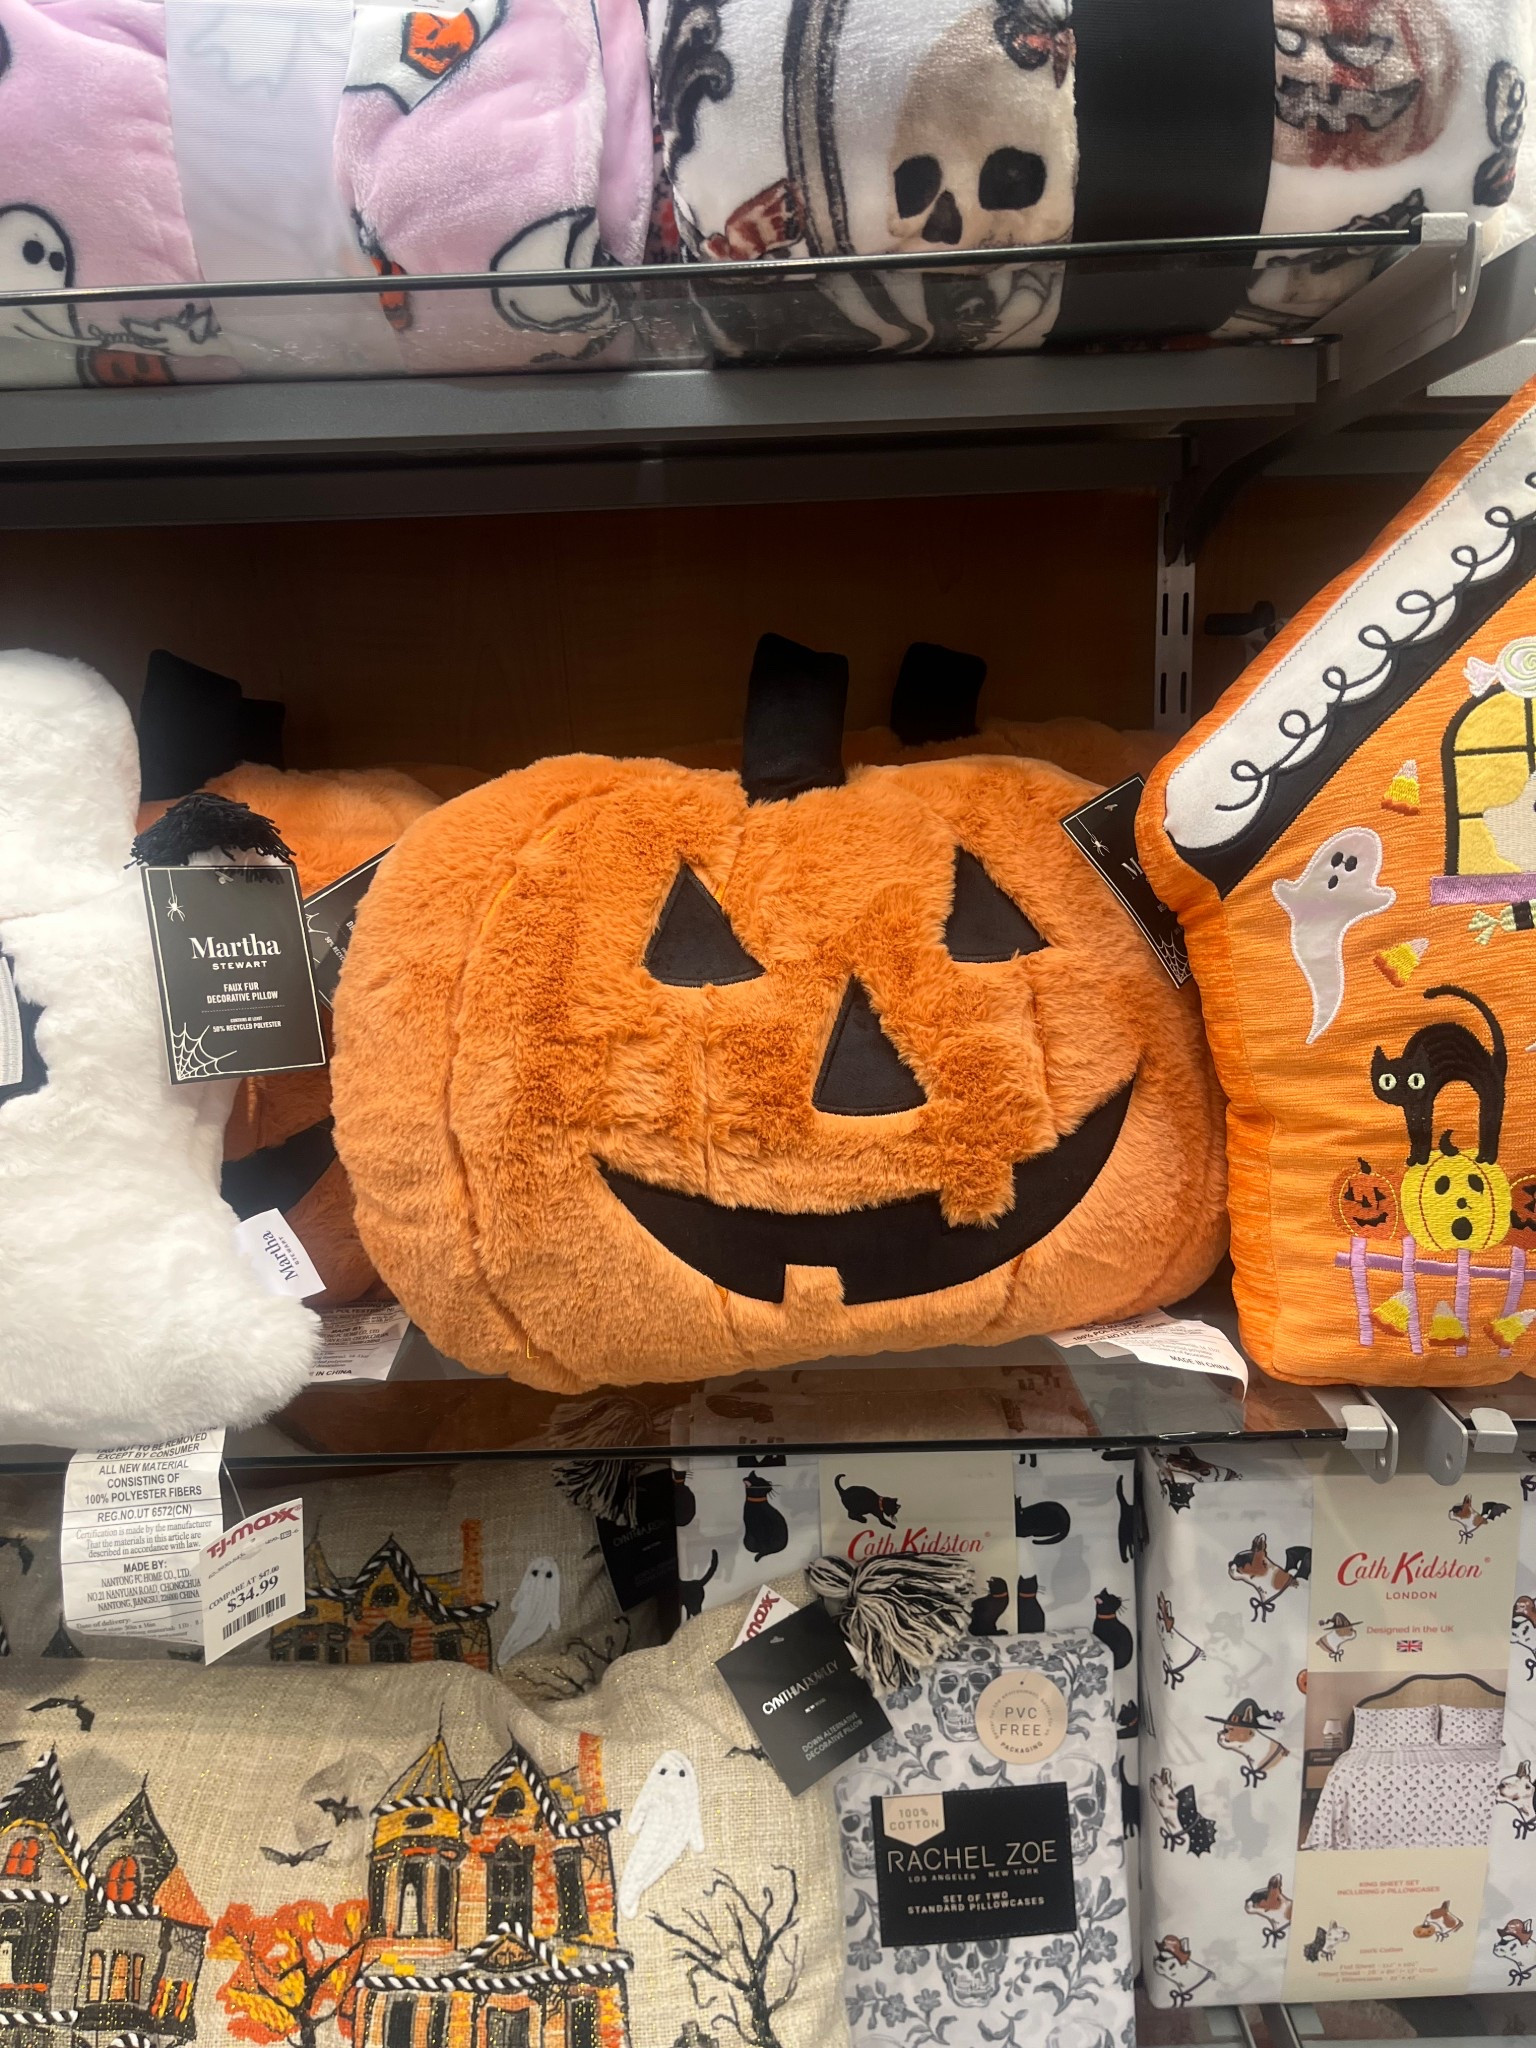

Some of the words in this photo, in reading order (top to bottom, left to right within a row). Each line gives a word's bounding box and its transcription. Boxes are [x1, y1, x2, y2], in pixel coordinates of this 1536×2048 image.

[189, 933, 282, 959] Martha
[212, 961, 267, 970] STEWART
[223, 983, 243, 992] FAUX
[244, 982, 259, 991] FUR
[207, 992, 250, 1004] DECORATIVE
[252, 991, 278, 1001] PILLOW
[226, 1023, 252, 1031] RECYCLED
[254, 1021, 281, 1030] POLYESTER
[262, 1230, 299, 1281] Martha
[152, 1442, 164, 1450] BE
[165, 1432, 208, 1447] REMOVED
[96, 1452, 132, 1460] EXCEPT
[134, 1451, 148, 1459] BY
[150, 1443, 200, 1458] CONSUMER
[99, 1464, 117, 1475] ALL
[119, 1463, 141, 1474] NEW
[142, 1459, 189, 1472] MATERIAL
[107, 1474, 165, 1489] CONSISTING
[167, 1473, 180, 1483] OF
[85, 1493, 109, 1505] 100%
[111, 1489, 167, 1502] POLYESTER
[169, 1485, 202, 1498] FIBERS
[97, 1508, 150, 1523] REG.NO.UT
[152, 1503, 192, 1518] 6572(CN)
[126, 1525, 145, 1535] made
[146, 1524, 154, 1534] by
[155, 1523, 166, 1532] the
[167, 1519, 212, 1531] manufacturer
[102, 1538, 114, 1548] the
[114, 1536, 145, 1546] materials
[154, 1534, 167, 1542] this
[168, 1532, 190, 1542] article
[848, 1529, 897, 1563] Cath
[900, 1527, 984, 1554] Kidston
[88, 1546, 121, 1559] described
[130, 1543, 169, 1554] accordance
[170, 1541, 185, 1550] with
[124, 1562, 149, 1573] MADE
[151, 1560, 167, 1570] BY:
[1337, 1552, 1390, 1586] Cath
[1391, 1551, 1483, 1585] Kidston
[101, 1573, 134, 1587] NANTONG
[143, 1571, 163, 1582] HOME
[160, 1579, 201, 1593] CHONGCHUA
[179, 1590, 200, 1600] CHINA
[209, 1583, 245, 1610] COMPARE
[246, 1576, 257, 1586] AT
[227, 1575, 279, 1613] $34.99
[1386, 1591, 1437, 1600] LONDON
[1366, 1625, 1410, 1637] Designed
[1440, 1625, 1454, 1633] UK
[1005, 1707, 1037, 1719] PVC
[1000, 1724, 1041, 1736] FREE
[802, 1735, 823, 1753] DOWN
[1000, 1740, 1043, 1753] PACKAGING
[899, 1807, 929, 1819] 100%
[889, 1819, 940, 1831] COTTON
[887, 1845, 996, 1874] RACHEL
[1006, 1840, 1058, 1866] ZOE
[908, 1875, 928, 1884] LOS
[931, 1873, 977, 1882] ANGELES
[988, 1869, 1009, 1878] NEW
[1013, 1867, 1040, 1877] YORK
[942, 1894, 963, 1904] SET
[967, 1893, 982, 1903] OF
[985, 1890, 1009, 1900] TWO
[907, 1903, 966, 1915] STANDARD
[969, 1896, 1045, 1911] PILLOWCASES
